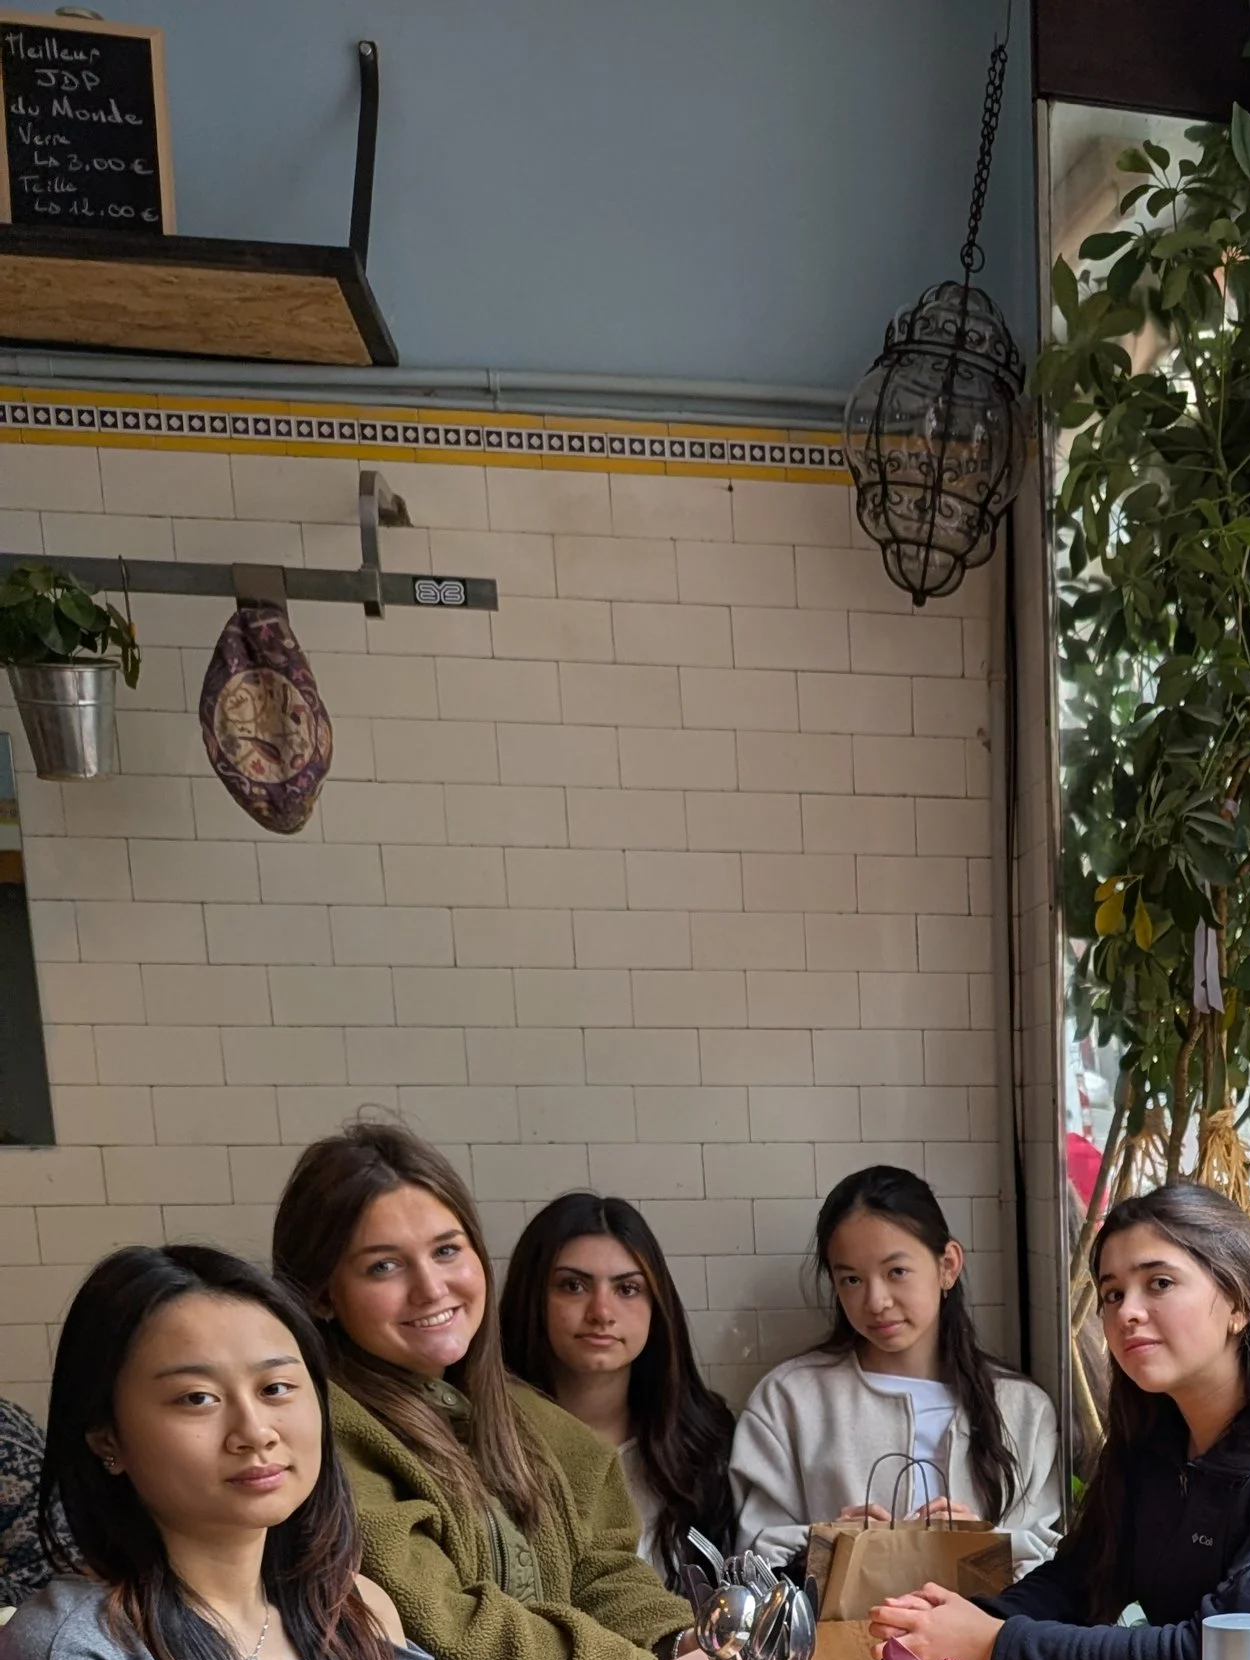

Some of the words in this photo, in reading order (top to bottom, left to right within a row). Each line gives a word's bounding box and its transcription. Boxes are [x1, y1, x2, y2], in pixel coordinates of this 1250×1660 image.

[34, 69, 100, 91] JDP
[10, 96, 40, 116] du
[52, 95, 143, 125] Monde
[19, 121, 71, 145] Verre
